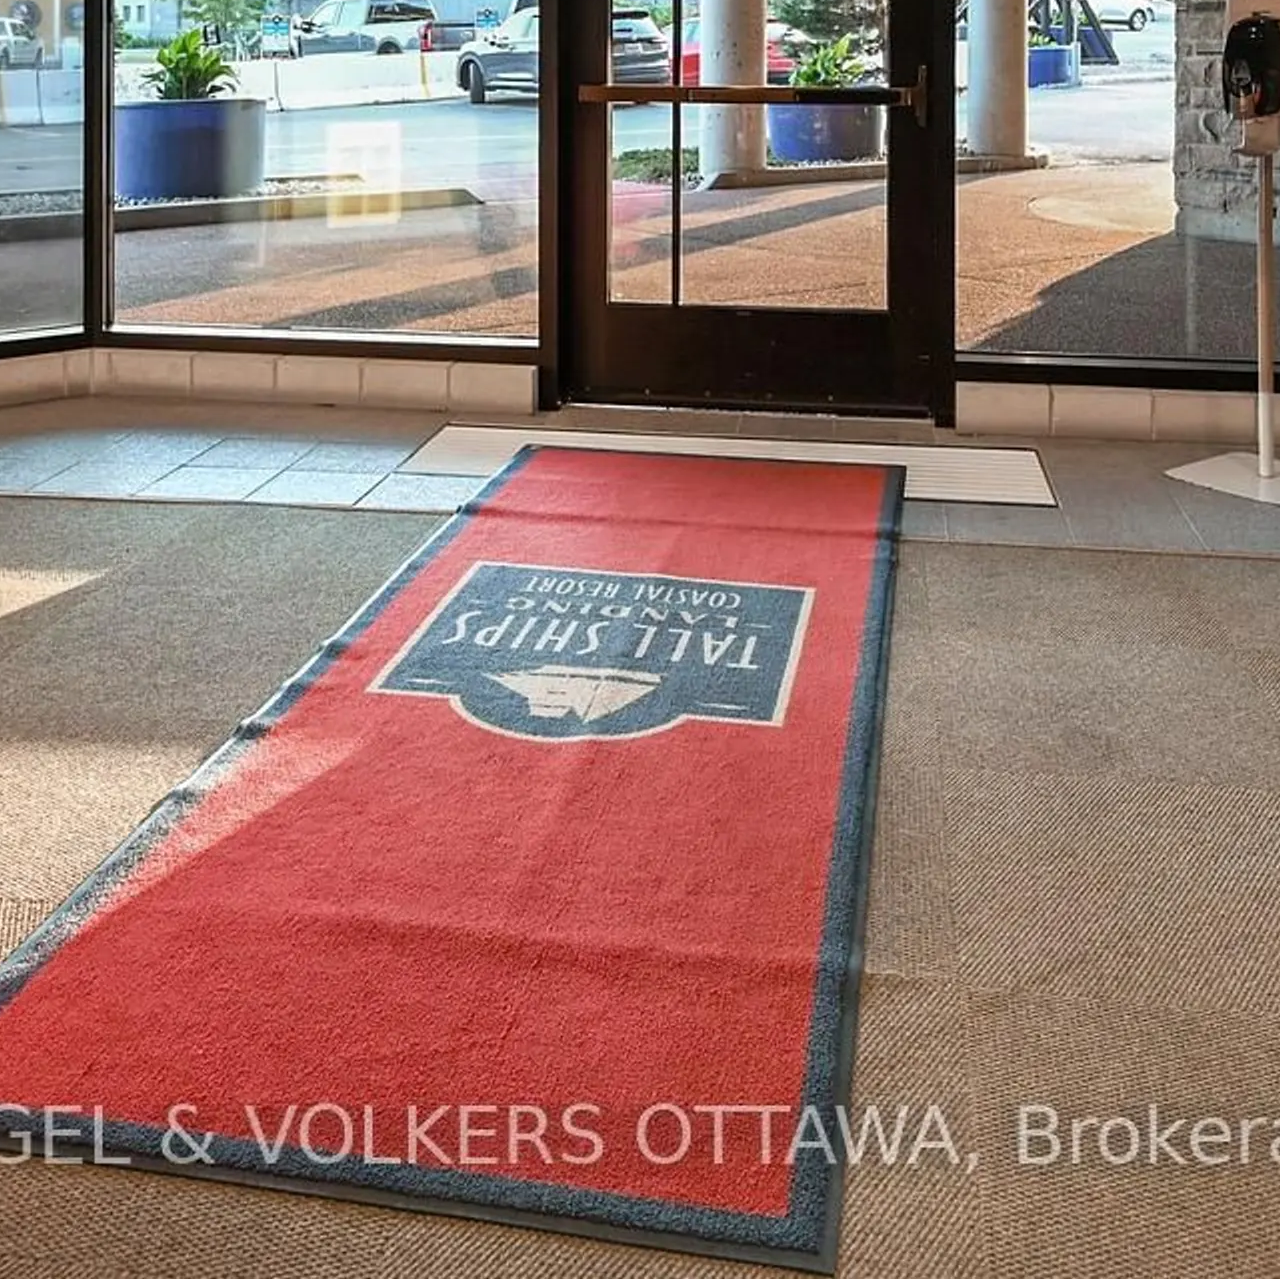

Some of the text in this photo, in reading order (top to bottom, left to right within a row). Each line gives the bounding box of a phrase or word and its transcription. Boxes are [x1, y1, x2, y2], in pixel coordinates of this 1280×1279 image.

[520, 576, 741, 609] COASTAL RESORT
[505, 596, 738, 629] LANDING
[441, 610, 760, 670] TALL SHIPS
